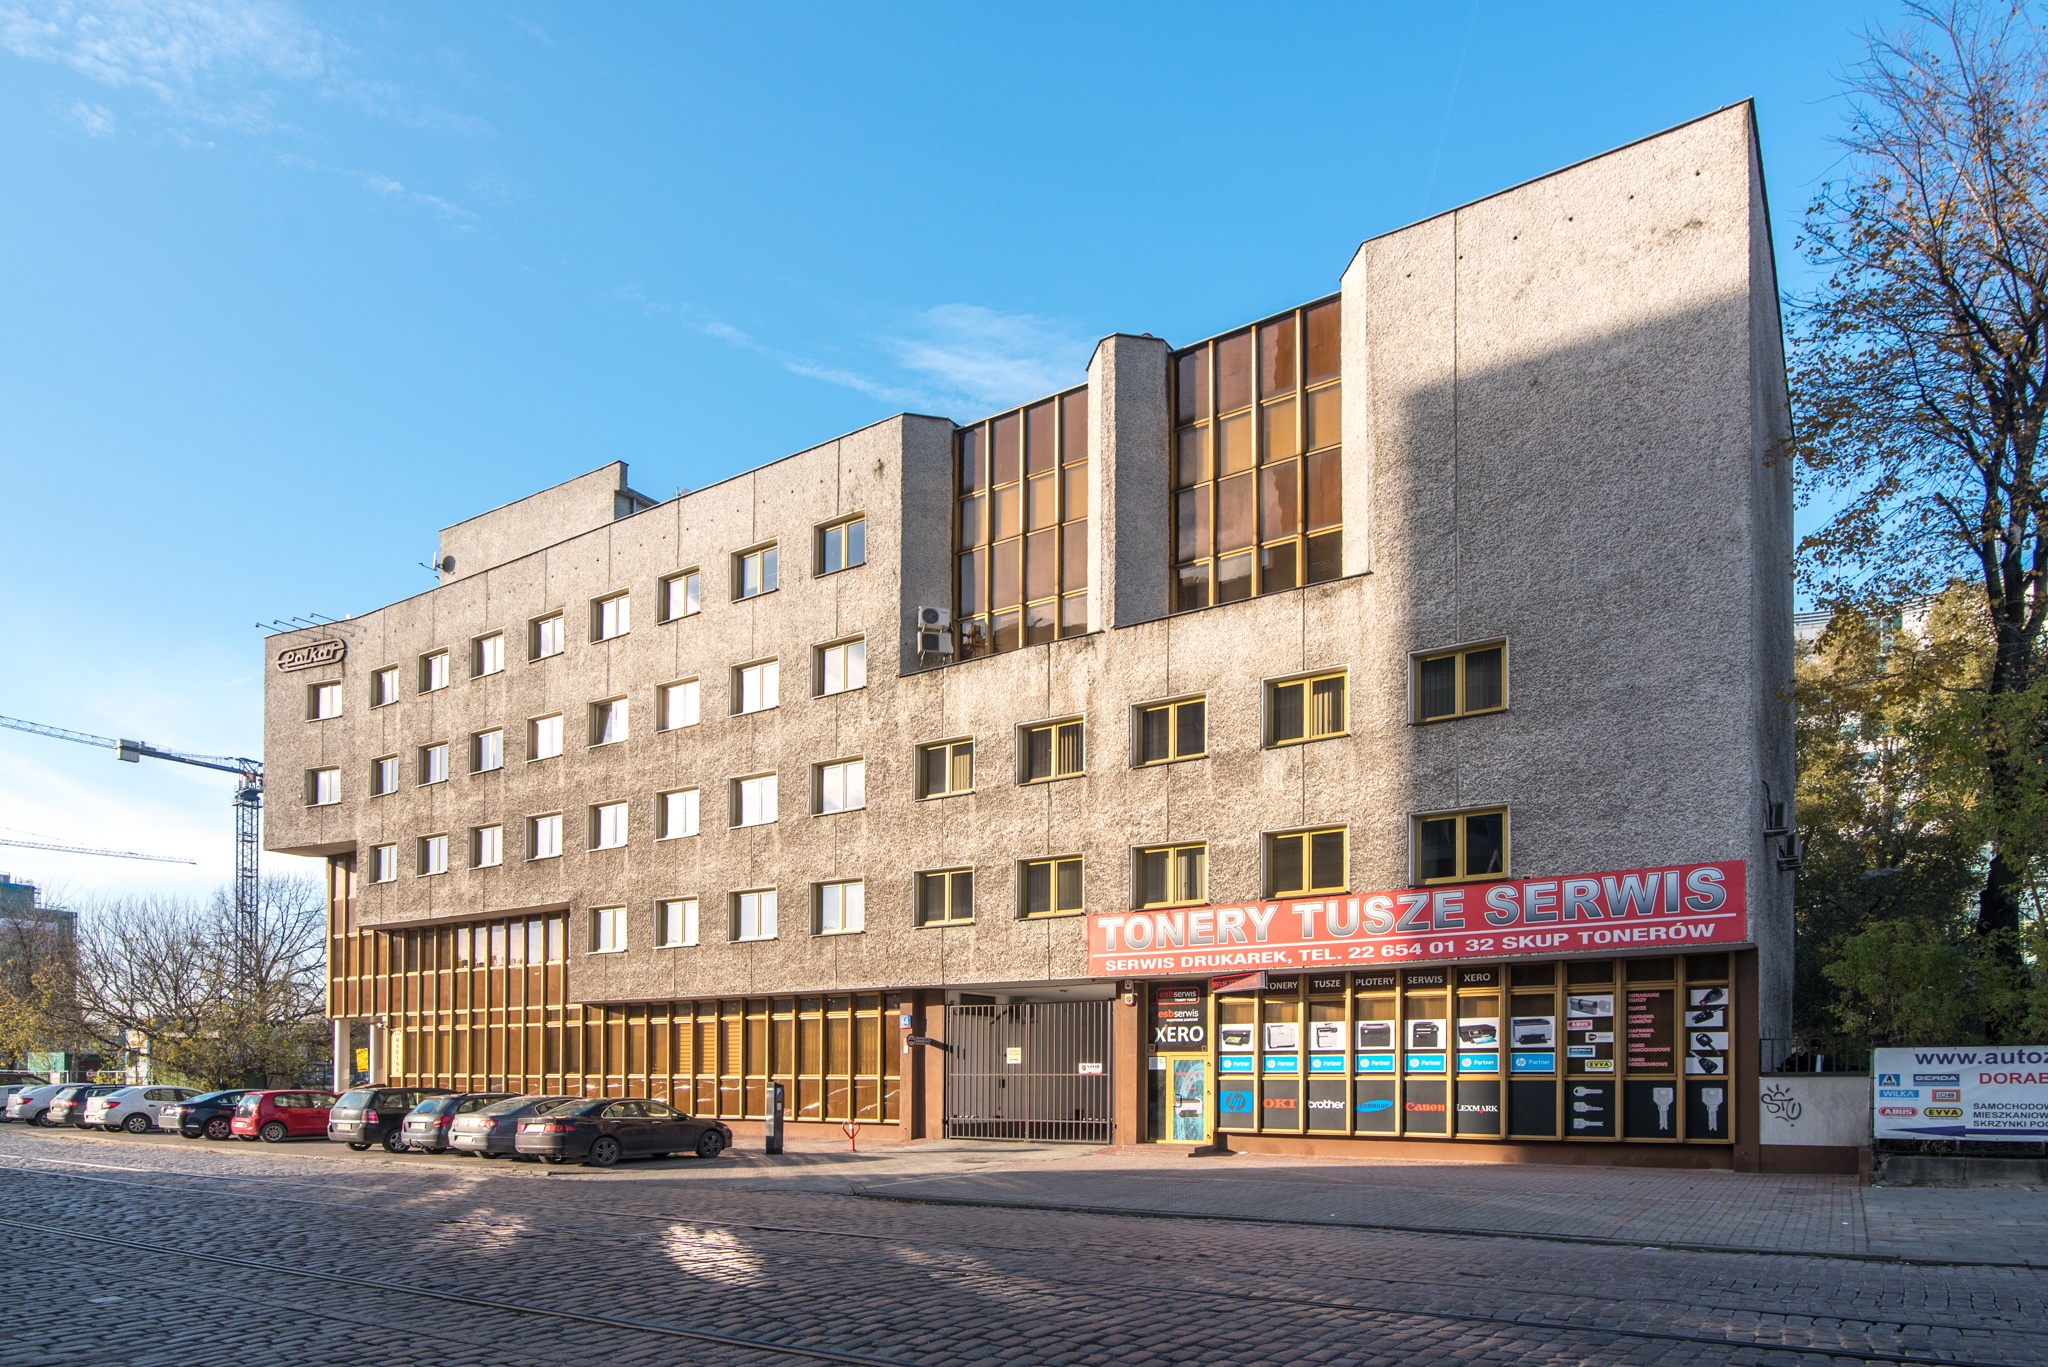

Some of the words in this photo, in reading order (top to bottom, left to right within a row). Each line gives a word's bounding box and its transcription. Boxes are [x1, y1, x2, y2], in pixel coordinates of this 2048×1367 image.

[1098, 905, 1279, 951] TONERY
[1292, 889, 1465, 939] TUSZE
[1484, 867, 1726, 926] SERWIS
[1105, 957, 1174, 972] SERWIS
[1181, 949, 1292, 968] DRUKAREK,
[1298, 948, 1342, 962] TEL.
[1348, 946, 1374, 960] 22
[1380, 942, 1422, 958] 654
[1429, 940, 1454, 954] 01
[1465, 938, 1494, 952] 32
[1502, 933, 1569, 950] SKUP
[1577, 922, 1715, 945] TONERÓW
[1356, 977, 1394, 986] PLOTERY
[1407, 975, 1443, 984] SERWIS
[1464, 973, 1491, 982] XERO
[1268, 981, 1298, 990] ONERY
[1314, 980, 1340, 988] TUSZE
[1158, 1009, 1199, 1018] esbserwis
[1155, 1026, 1204, 1043] XERO
[1263, 1098, 1298, 1109] OKI
[1308, 1100, 1345, 1109] brother
[1405, 1102, 1445, 1112] Canon
